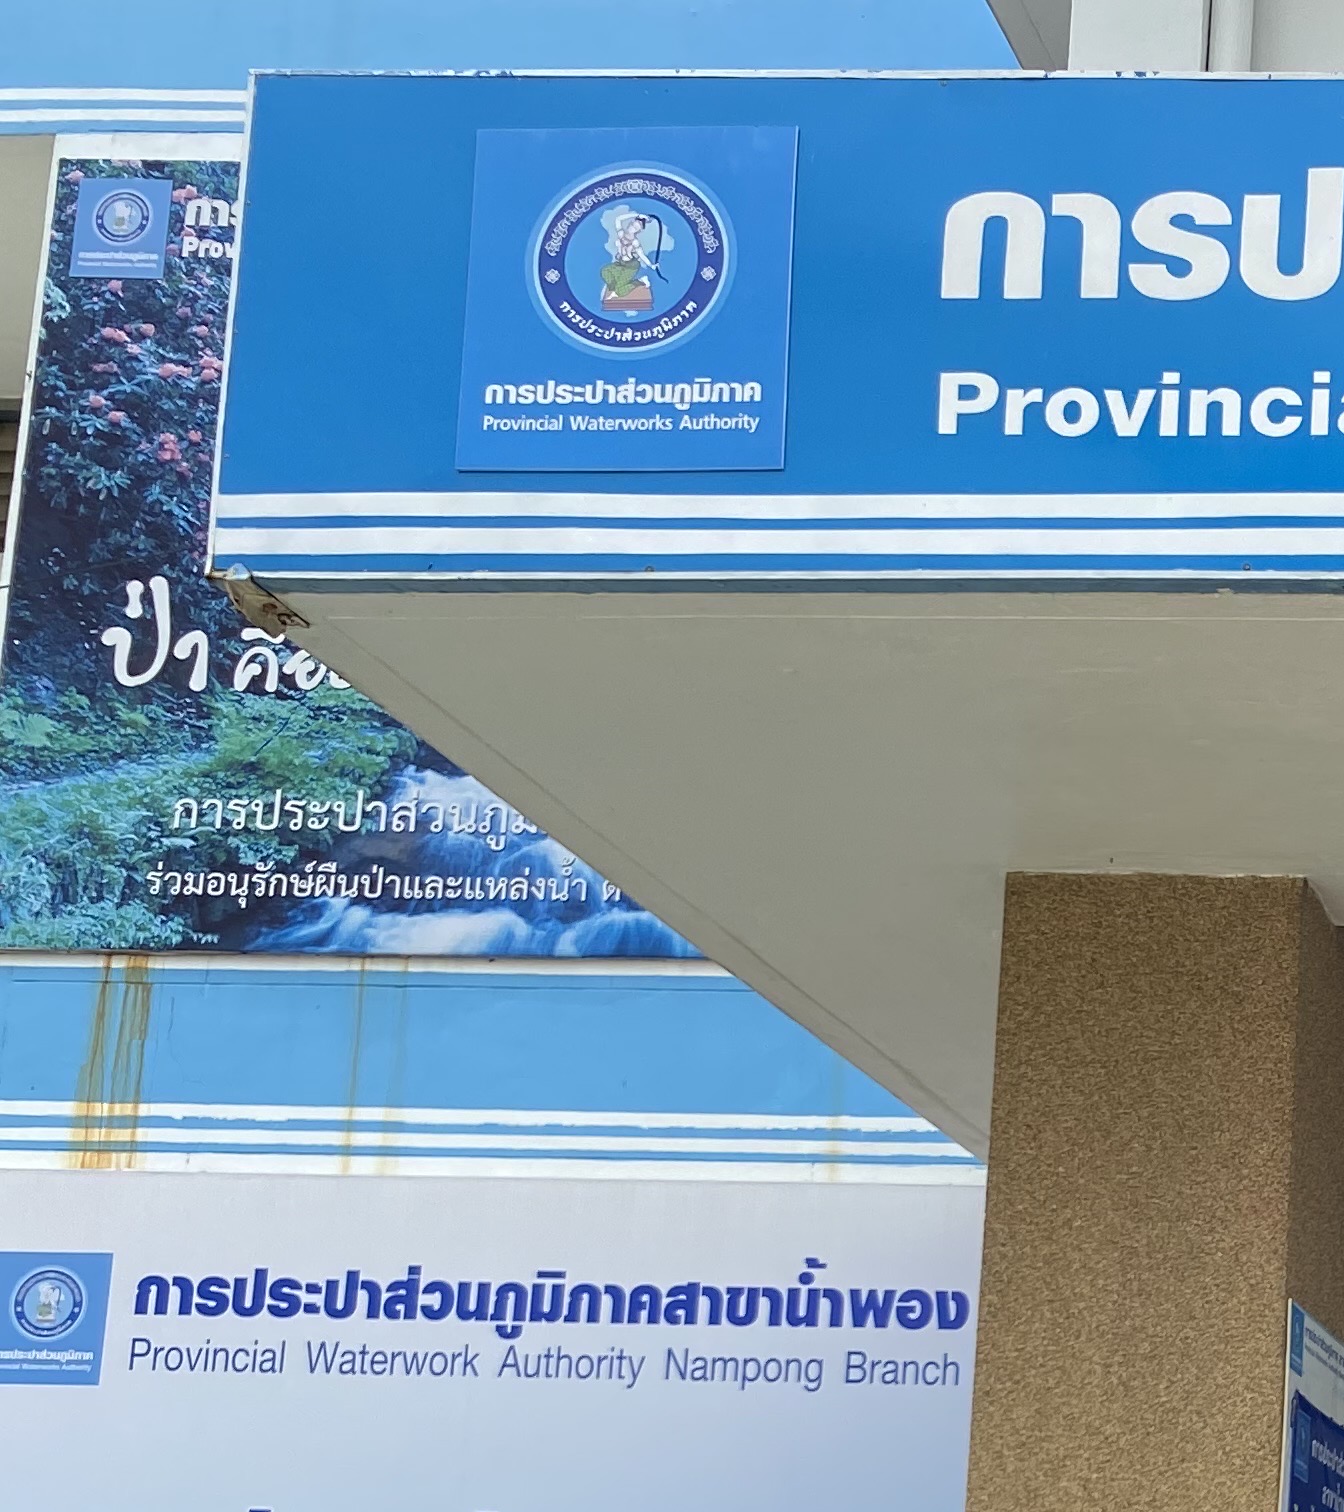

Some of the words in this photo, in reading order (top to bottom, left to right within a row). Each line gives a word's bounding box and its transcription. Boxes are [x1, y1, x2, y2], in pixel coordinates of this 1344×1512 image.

[484, 377, 762, 411] การประปาส่วนภูมิภาค
[482, 414, 563, 431] Provincial
[569, 414, 674, 431] Waterworks
[678, 412, 760, 434] Authority
[100, 575, 209, 693] ป่า
[145, 856, 588, 909] ร่วมอนุรักษ์ผืนป่าและแหล่งน้ำ
[132, 1257, 972, 1340] การประปาส่วนภูมิภาคสาขาน้ำพอง
[127, 1337, 287, 1376] Provincial
[304, 1340, 479, 1379] Waterwork
[497, 1343, 647, 1390] Authority
[663, 1347, 825, 1391] Nampong
[843, 1350, 961, 1389] Branch
